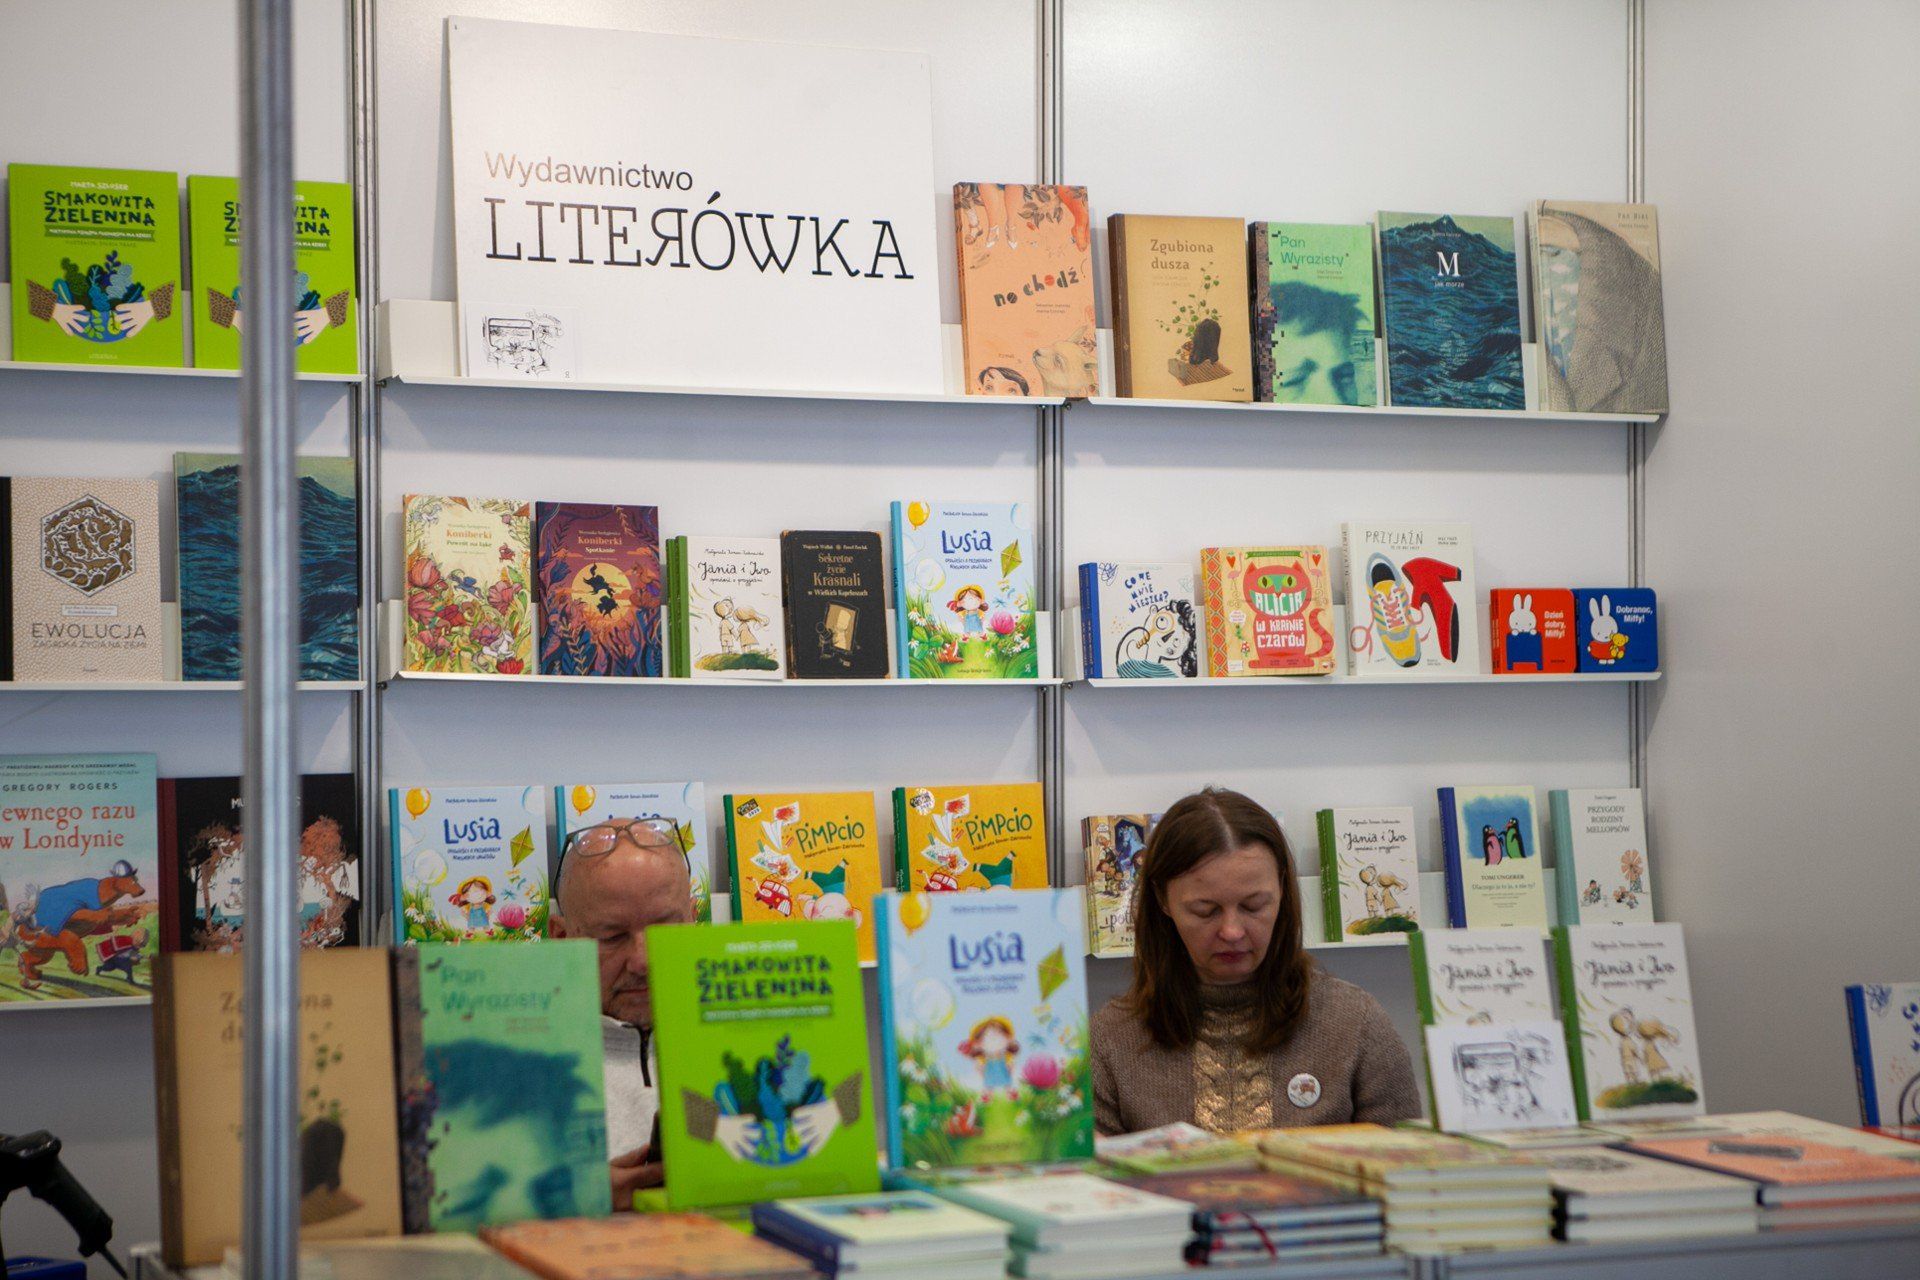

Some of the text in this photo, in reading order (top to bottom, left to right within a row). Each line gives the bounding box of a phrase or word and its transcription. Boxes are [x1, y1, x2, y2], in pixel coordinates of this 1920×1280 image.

[484, 151, 693, 191] Wydawnictwo
[44, 190, 155, 209] SMAKOWITA
[45, 207, 156, 226] ZIELENINA
[1150, 239, 1214, 255] Zgubiona
[1280, 235, 1306, 248] Pan
[1151, 257, 1190, 270] dusza
[1280, 251, 1344, 268] Wyrazisty
[1436, 251, 1461, 277] M
[993, 266, 1080, 307] no chodź
[446, 529, 492, 539] Koniberki
[578, 536, 623, 545] Koniberki
[941, 529, 993, 554] Lusia
[1365, 530, 1423, 545] PRZYJAŹŃ
[818, 552, 855, 564] Sekretne
[697, 561, 737, 581] Jania
[740, 563, 746, 574] i
[826, 563, 847, 576] życie
[813, 572, 861, 587] Krasnali
[1125, 576, 1136, 589] CO
[1254, 591, 1303, 617] ALICJA
[1615, 605, 1653, 615] Dobranoc,
[1544, 620, 1566, 629] dobry,
[1624, 614, 1645, 624] Miffy!
[31, 623, 147, 639] EWOLUCJA
[1544, 629, 1565, 638] Miffy!
[3, 782, 118, 792] GREGORY ROGERS
[1, 805, 136, 831] ewnego razu
[443, 817, 502, 844] Lusia
[0, 825, 125, 857] w Londynie
[948, 930, 1026, 970] Lusia
[696, 955, 831, 978] SMAKOWITA
[697, 978, 833, 1003] ZIELENINA
